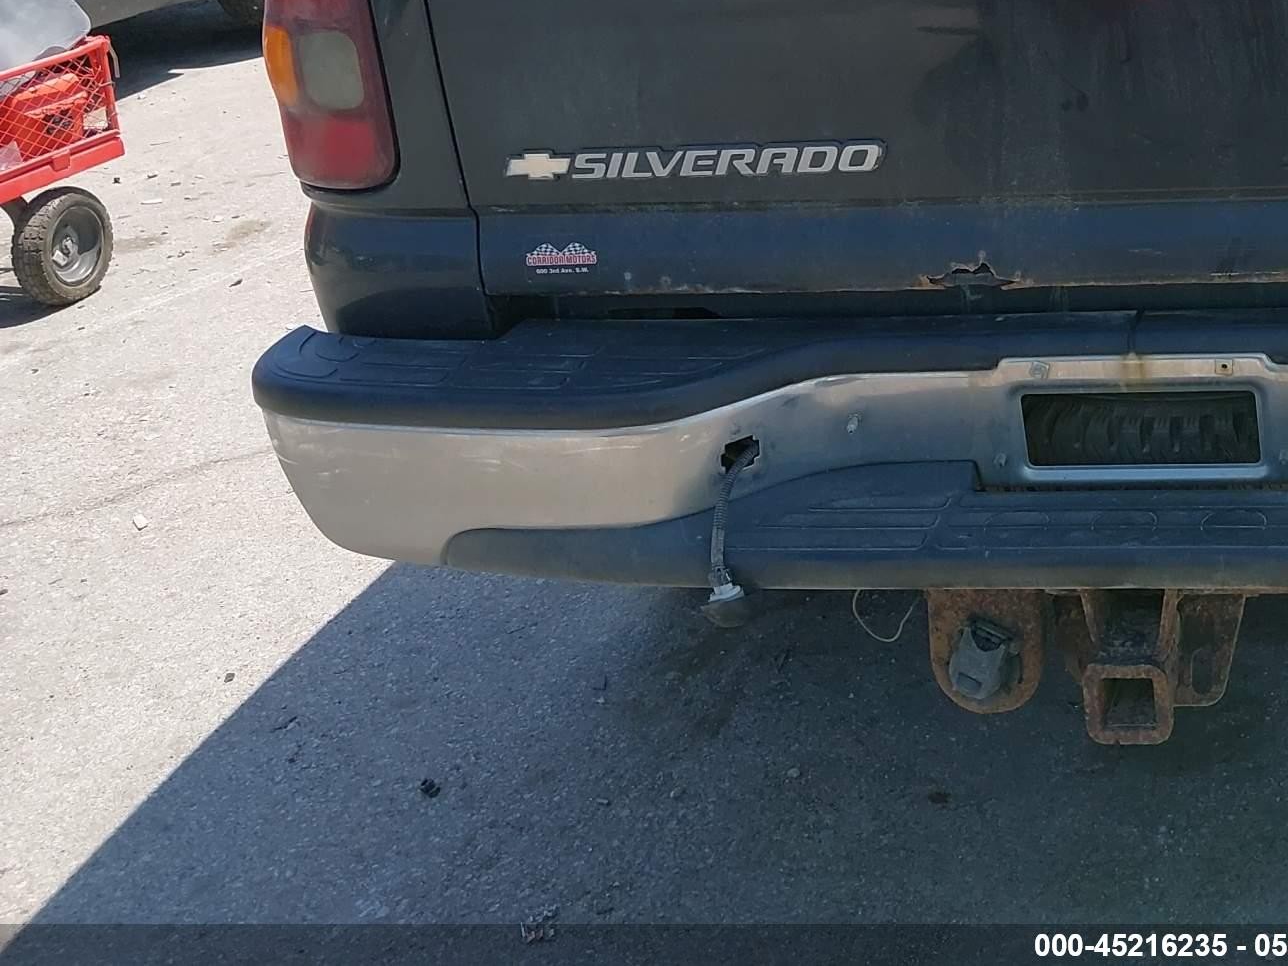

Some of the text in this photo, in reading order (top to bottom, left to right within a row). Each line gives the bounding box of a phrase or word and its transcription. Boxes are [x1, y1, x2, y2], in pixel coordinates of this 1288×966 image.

[571, 143, 884, 180] SILVERADO
[527, 253, 597, 266] CORRIDOR MOTORS
